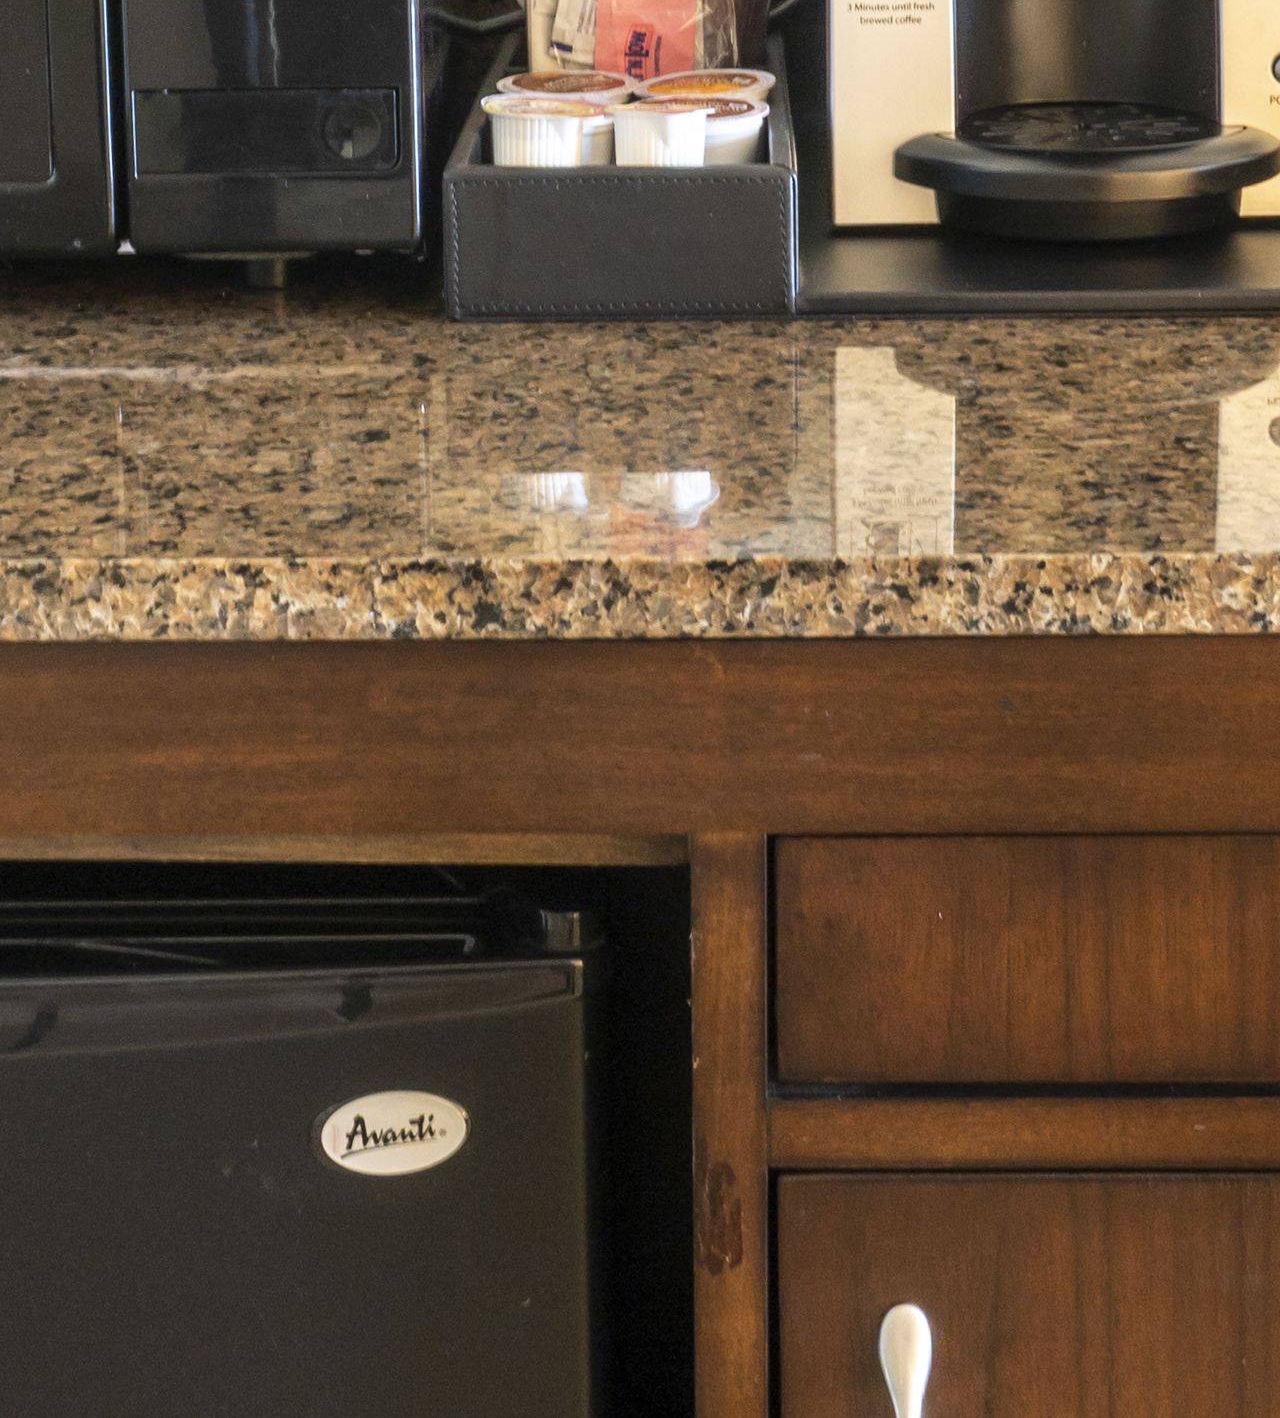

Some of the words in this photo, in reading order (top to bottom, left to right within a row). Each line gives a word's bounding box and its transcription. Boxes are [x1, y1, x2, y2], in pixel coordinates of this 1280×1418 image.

[854, 2, 890, 12] Minutes
[892, 2, 912, 12] until
[913, 1, 935, 11] fresh
[860, 15, 893, 25] brewed
[895, 14, 922, 24] coffee
[345, 1113, 436, 1150] Avanti
